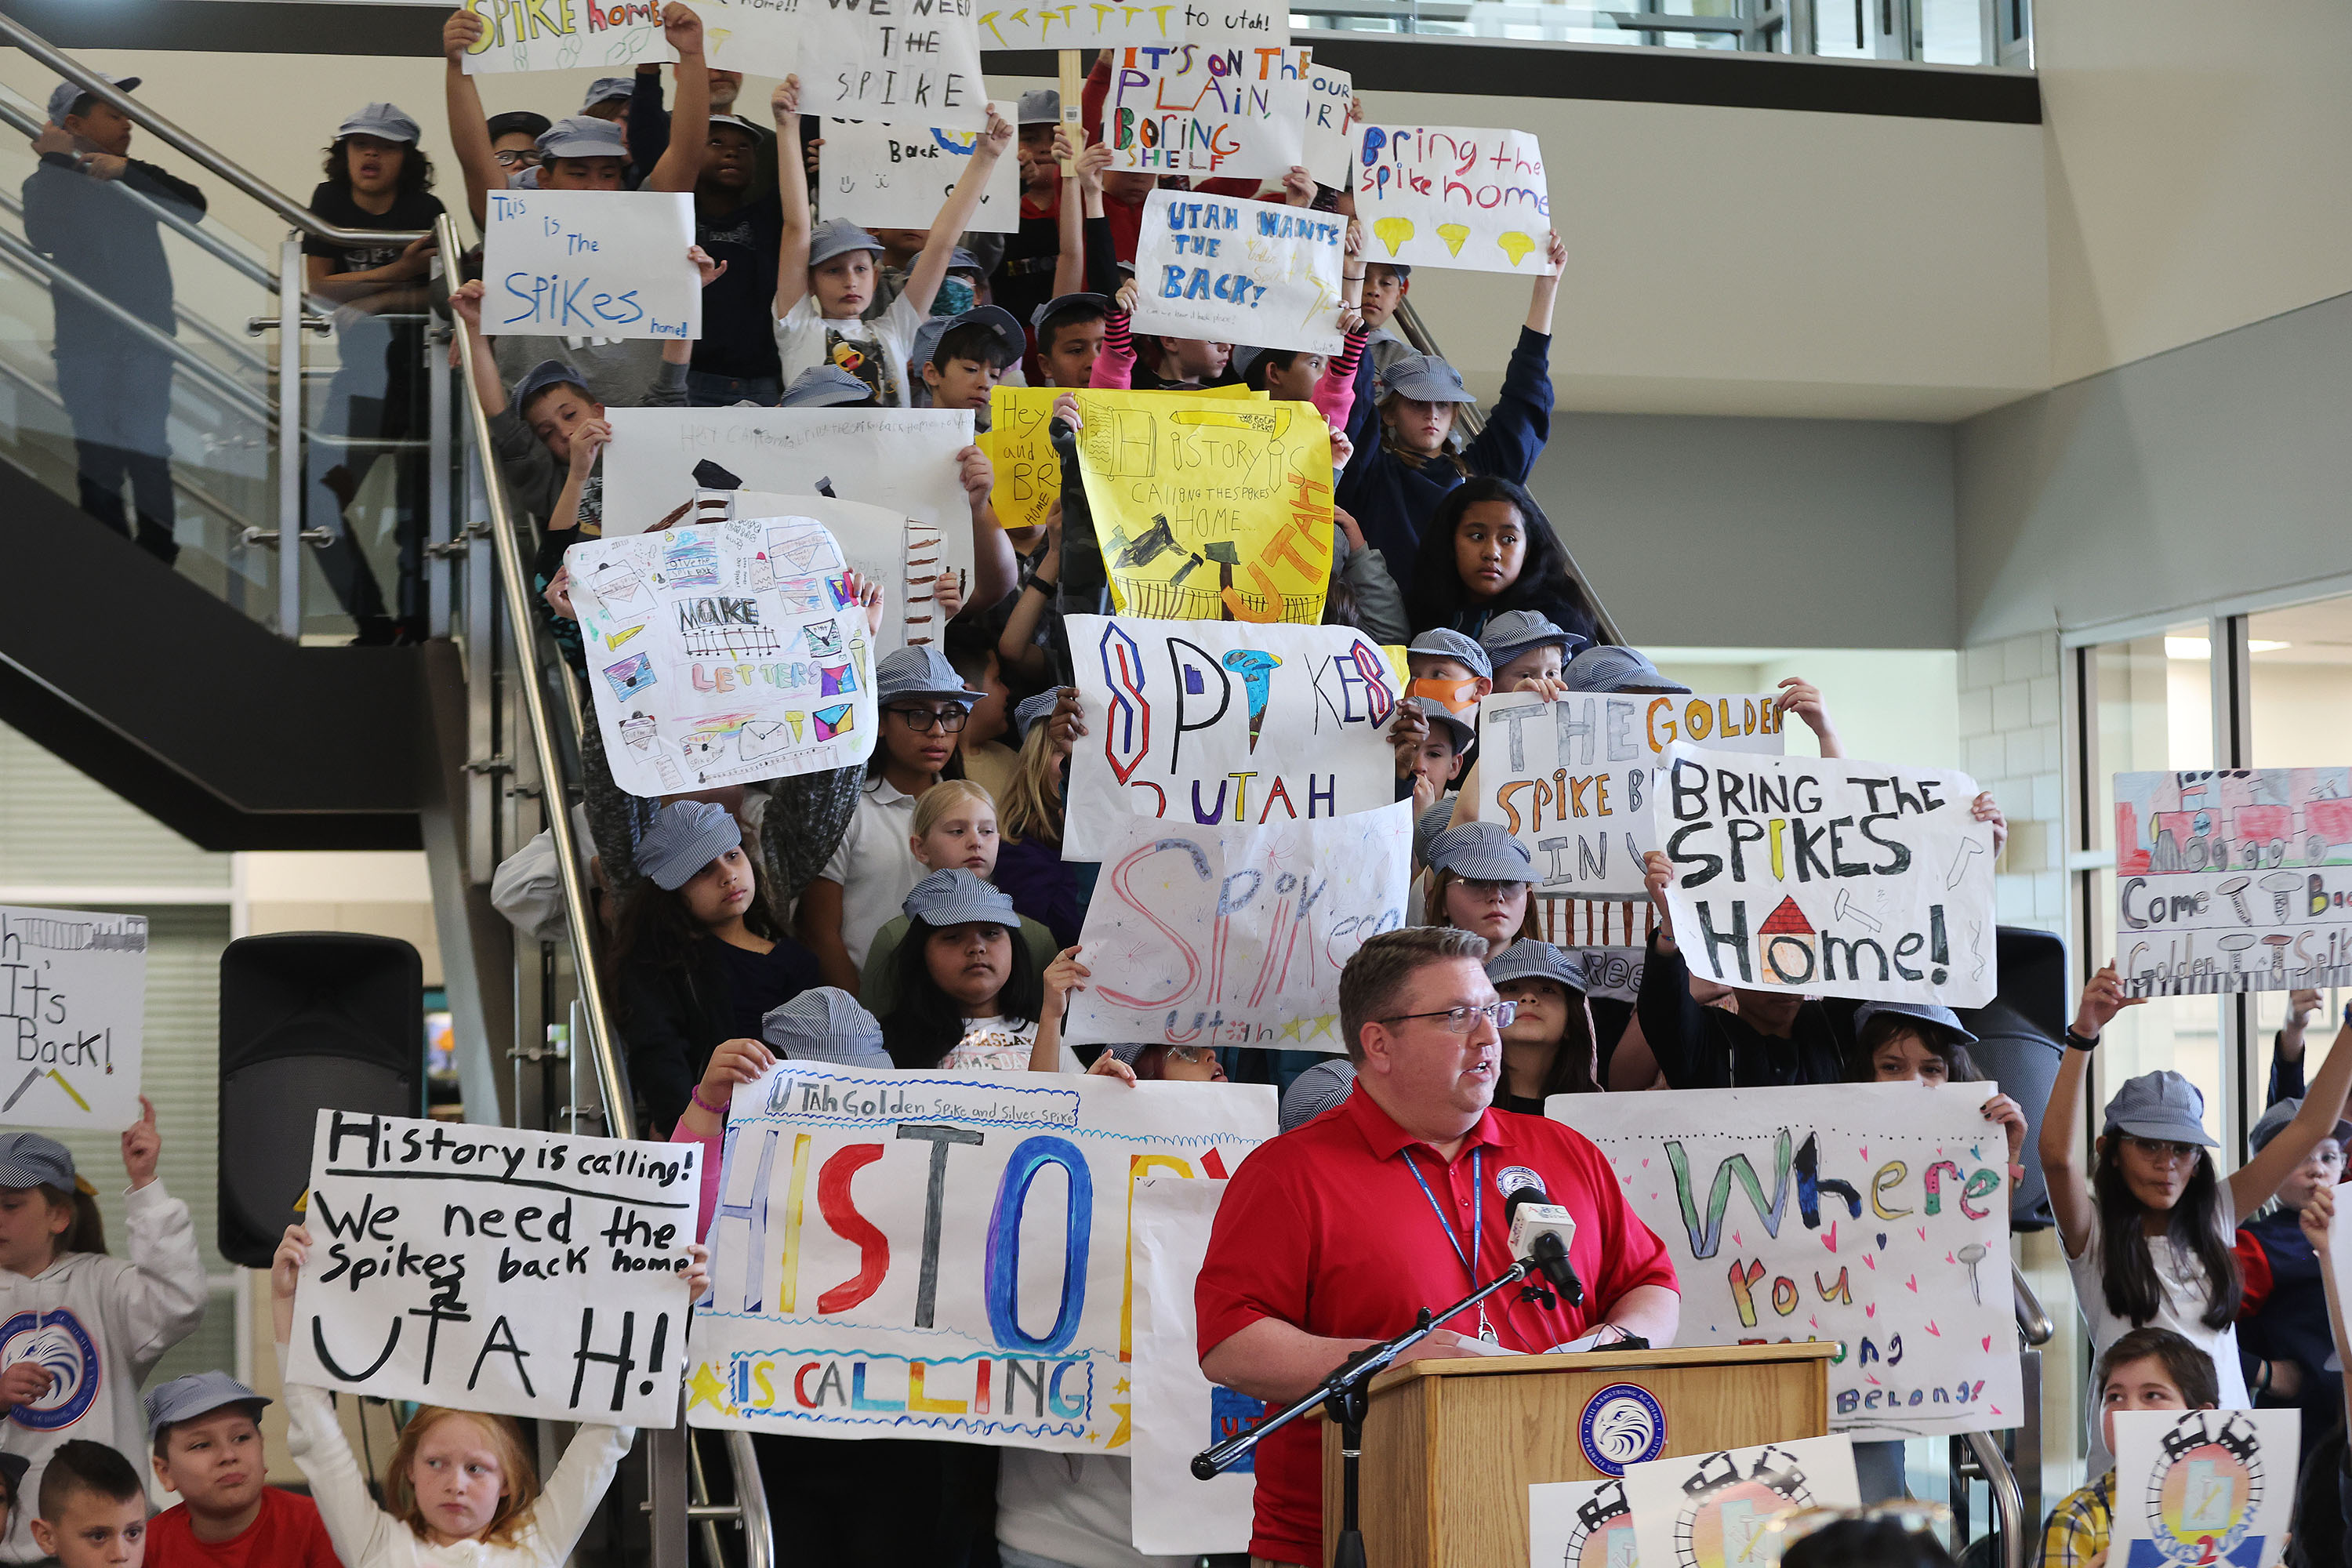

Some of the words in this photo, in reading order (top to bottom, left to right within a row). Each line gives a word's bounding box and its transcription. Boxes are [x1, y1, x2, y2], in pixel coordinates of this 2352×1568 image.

[1185, 4, 1209, 27] to
[880, 27, 940, 56] THE
[1122, 44, 1199, 76] IT'S
[1207, 49, 1243, 78] ON
[1312, 78, 1349, 99] OUR
[889, 140, 939, 163] Back
[1127, 143, 1225, 172] SHELF
[1361, 126, 1477, 176] Bring
[1490, 141, 1541, 176] the
[492, 196, 527, 221] This
[1443, 176, 1550, 217] home
[544, 216, 561, 237] is
[567, 233, 600, 256] The
[1167, 201, 1238, 230] UTAH
[1257, 211, 1339, 245] WANTS
[1172, 234, 1221, 257] THE
[1159, 264, 1267, 308] BACK!
[1004, 394, 1046, 438] Hey
[1004, 442, 1034, 460] and
[1024, 492, 1050, 526] HOME
[1220, 472, 1333, 624] UTAH
[691, 661, 822, 693] LETTERS
[1490, 698, 1639, 772] THE
[1192, 772, 1335, 825] UTAH
[1671, 758, 1822, 822] BRING
[1538, 832, 1609, 887] IN
[1667, 812, 1911, 889] SPIKES
[2122, 877, 2210, 929] Come
[2129, 933, 2219, 987] Golden
[843, 1090, 924, 1116] Golden
[973, 1102, 996, 1119] and
[329, 1110, 525, 1181] History
[537, 1140, 568, 1170] is
[577, 1150, 693, 1188] calling!
[1664, 1129, 2000, 1259] Where
[314, 1191, 400, 1243] We
[444, 1197, 572, 1244] need
[601, 1206, 677, 1250] the
[612, 1248, 689, 1273] home
[696, 1124, 1229, 1362] HISTO
[1729, 1258, 1851, 1327] You
[312, 1308, 669, 1411] UTAH!
[738, 1361, 775, 1407] IS
[795, 1359, 1085, 1419] CALLING
[1595, 1389, 1637, 1407] ARMSTRONG
[1638, 1393, 1661, 1423] ACADEMY
